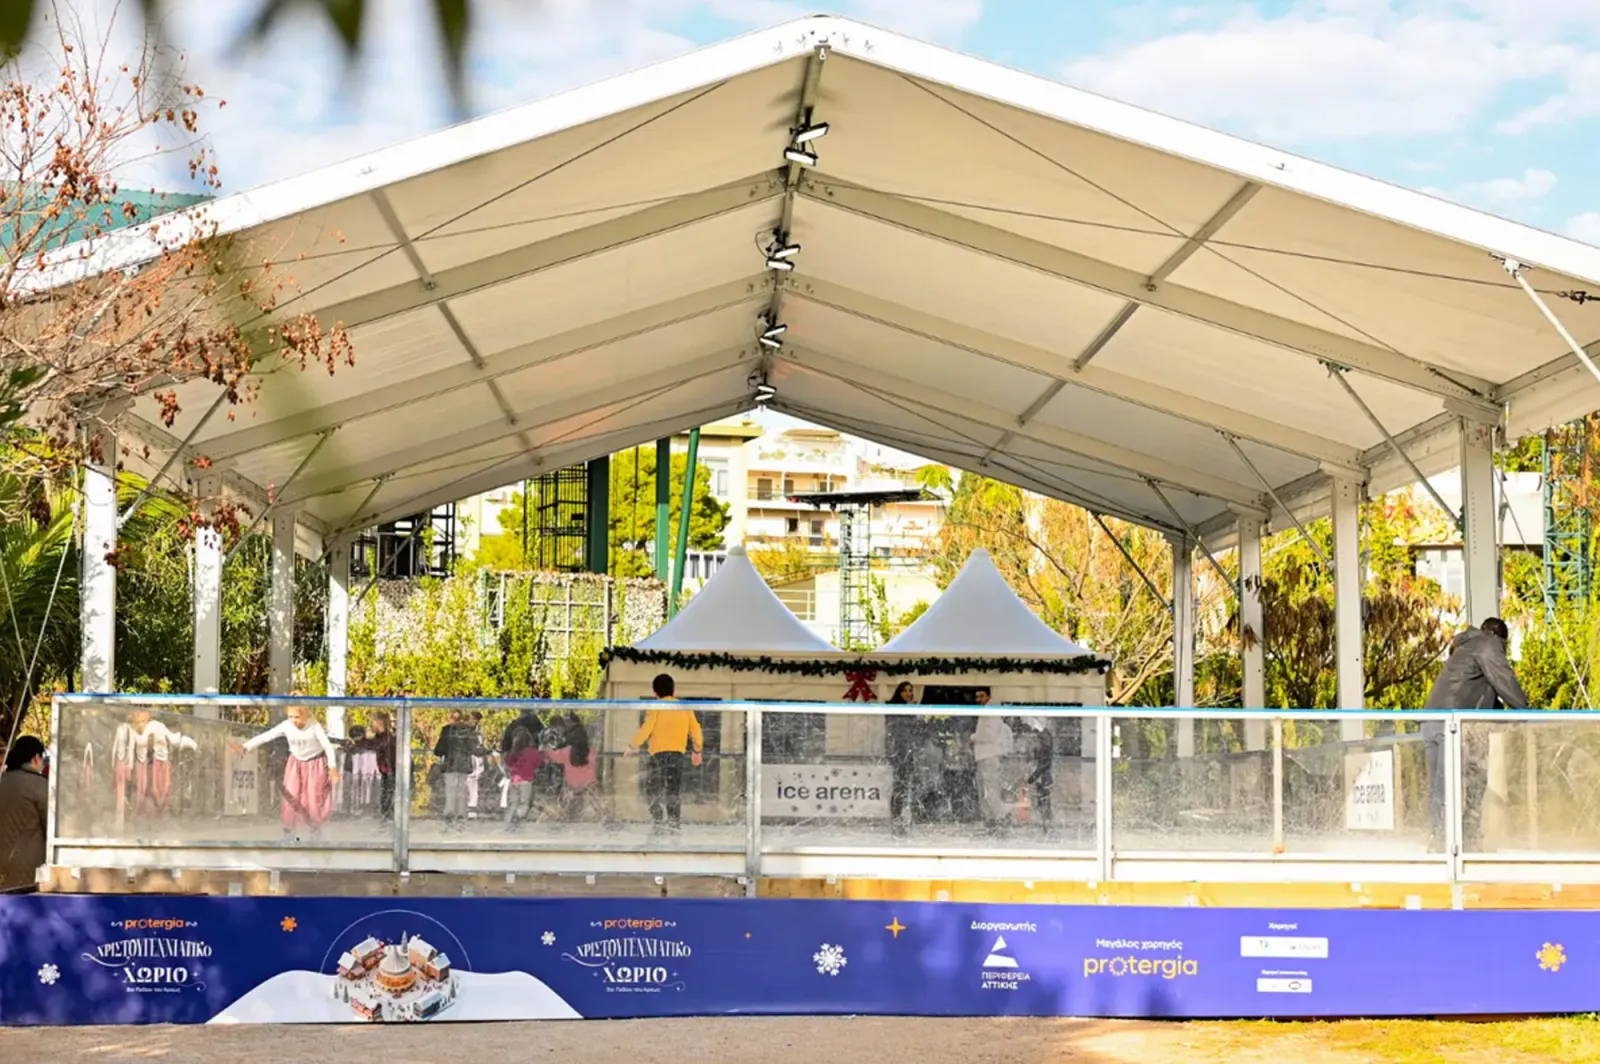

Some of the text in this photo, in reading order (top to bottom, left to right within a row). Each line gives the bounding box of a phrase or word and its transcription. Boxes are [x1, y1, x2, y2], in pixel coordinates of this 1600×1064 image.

[777, 781, 880, 800] ice arena
[124, 917, 185, 930] protergia
[604, 917, 663, 930] protergia
[970, 920, 1037, 932] Διοργανωτής
[1095, 938, 1184, 950] Μεγάλος χορηγός
[1083, 954, 1198, 979] protergia
[122, 964, 189, 984] ΧΩΡΙΟ
[602, 964, 668, 984] ΧΩΡΙΟ
[981, 971, 1031, 981] ΠΕΡΙΦΕΡΕΙΑ
[981, 980, 1018, 990] ΑΤΤΙΚΗΣ
